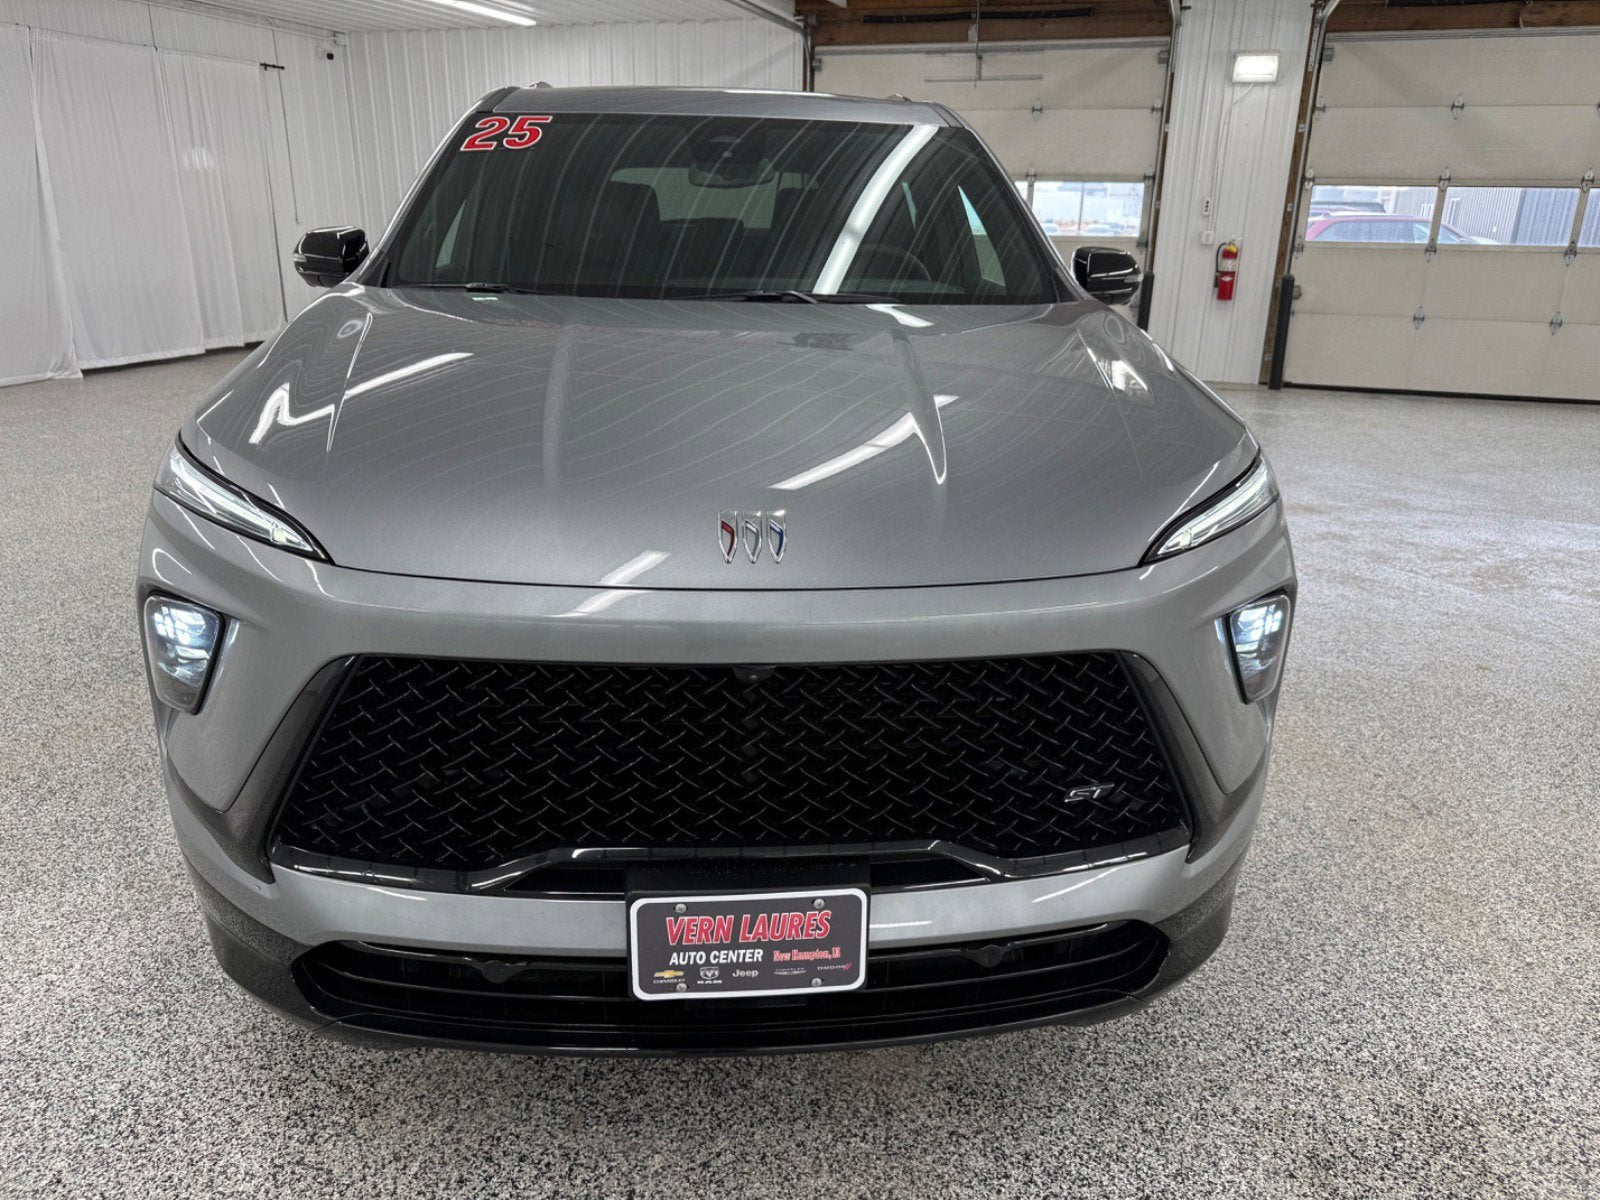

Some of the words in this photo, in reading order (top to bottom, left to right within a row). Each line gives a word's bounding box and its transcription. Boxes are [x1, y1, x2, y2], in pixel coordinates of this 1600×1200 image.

[460, 115, 553, 151] 25
[666, 915, 734, 946] VERN
[738, 911, 832, 943] LAURES
[669, 951, 706, 966] AUTO
[710, 949, 763, 964] CENTER
[773, 950, 791, 962] New
[732, 968, 759, 978] Jeep
